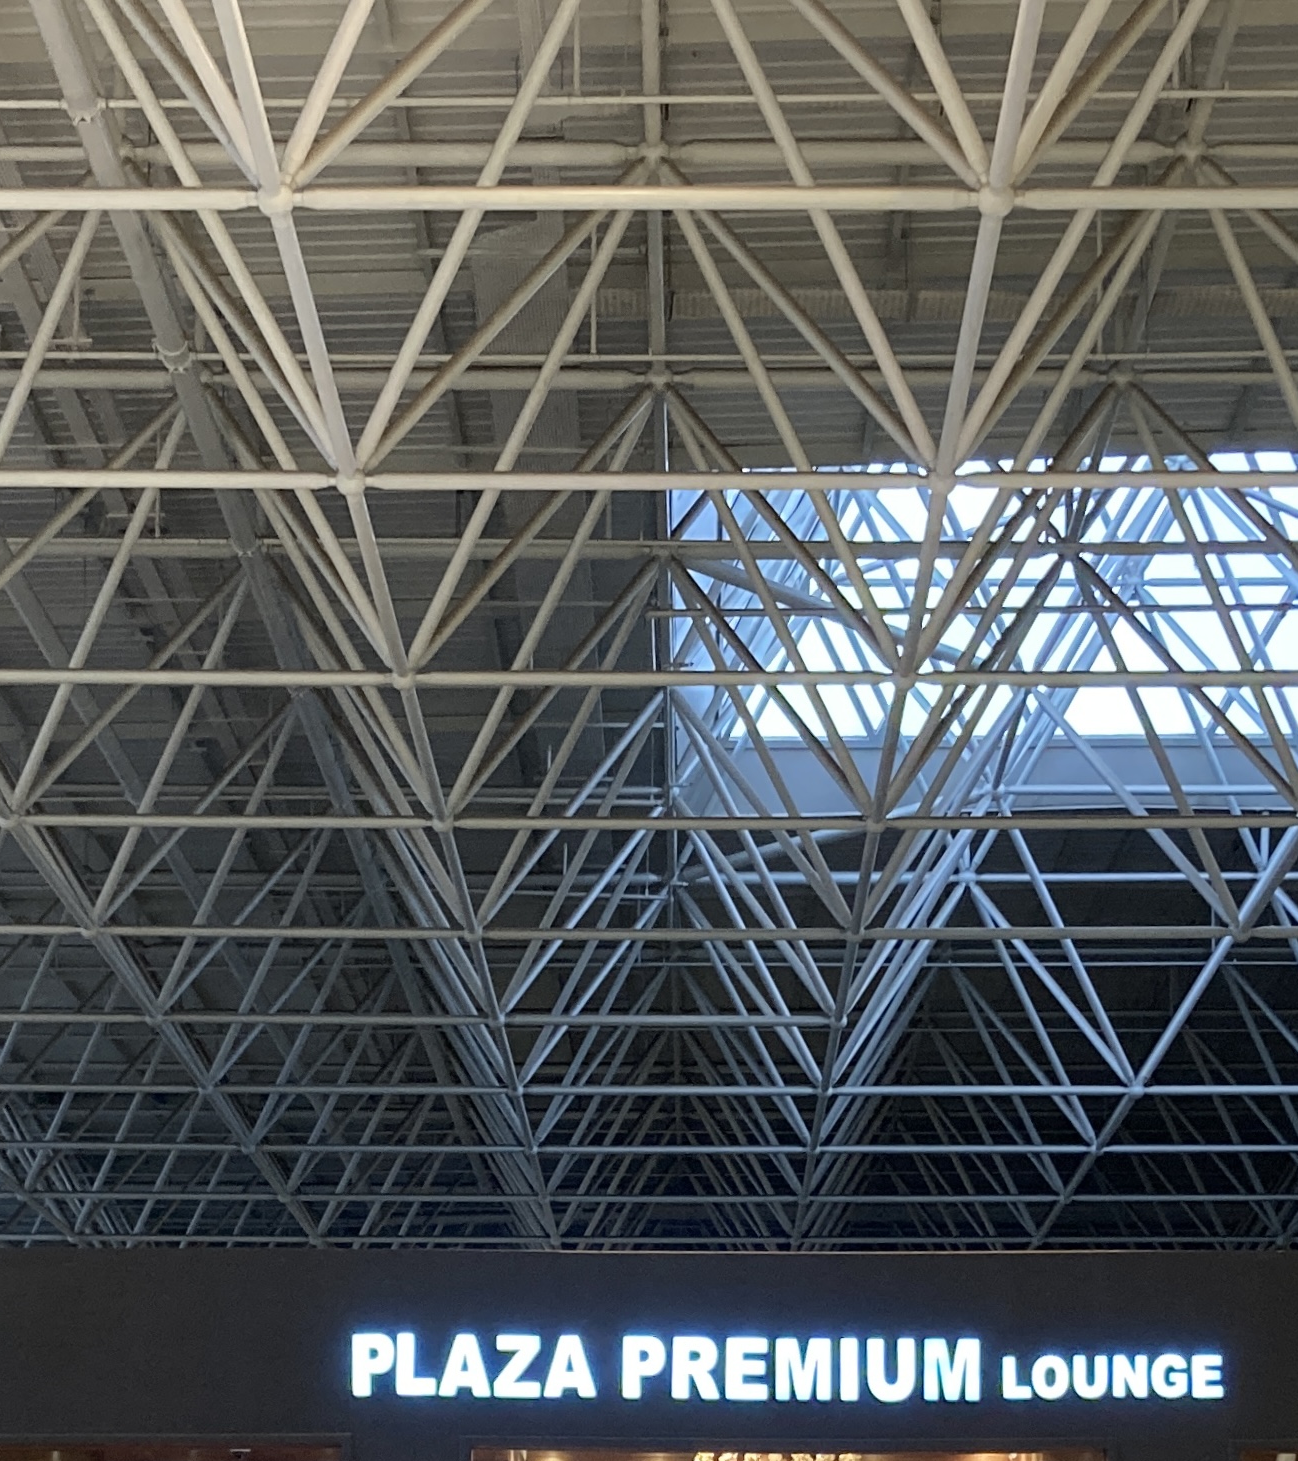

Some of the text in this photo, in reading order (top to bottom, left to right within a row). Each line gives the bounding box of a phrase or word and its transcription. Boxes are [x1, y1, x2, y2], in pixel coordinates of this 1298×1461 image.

[351, 1332, 1224, 1402] PLAZA PREMIUM LOUNGE
